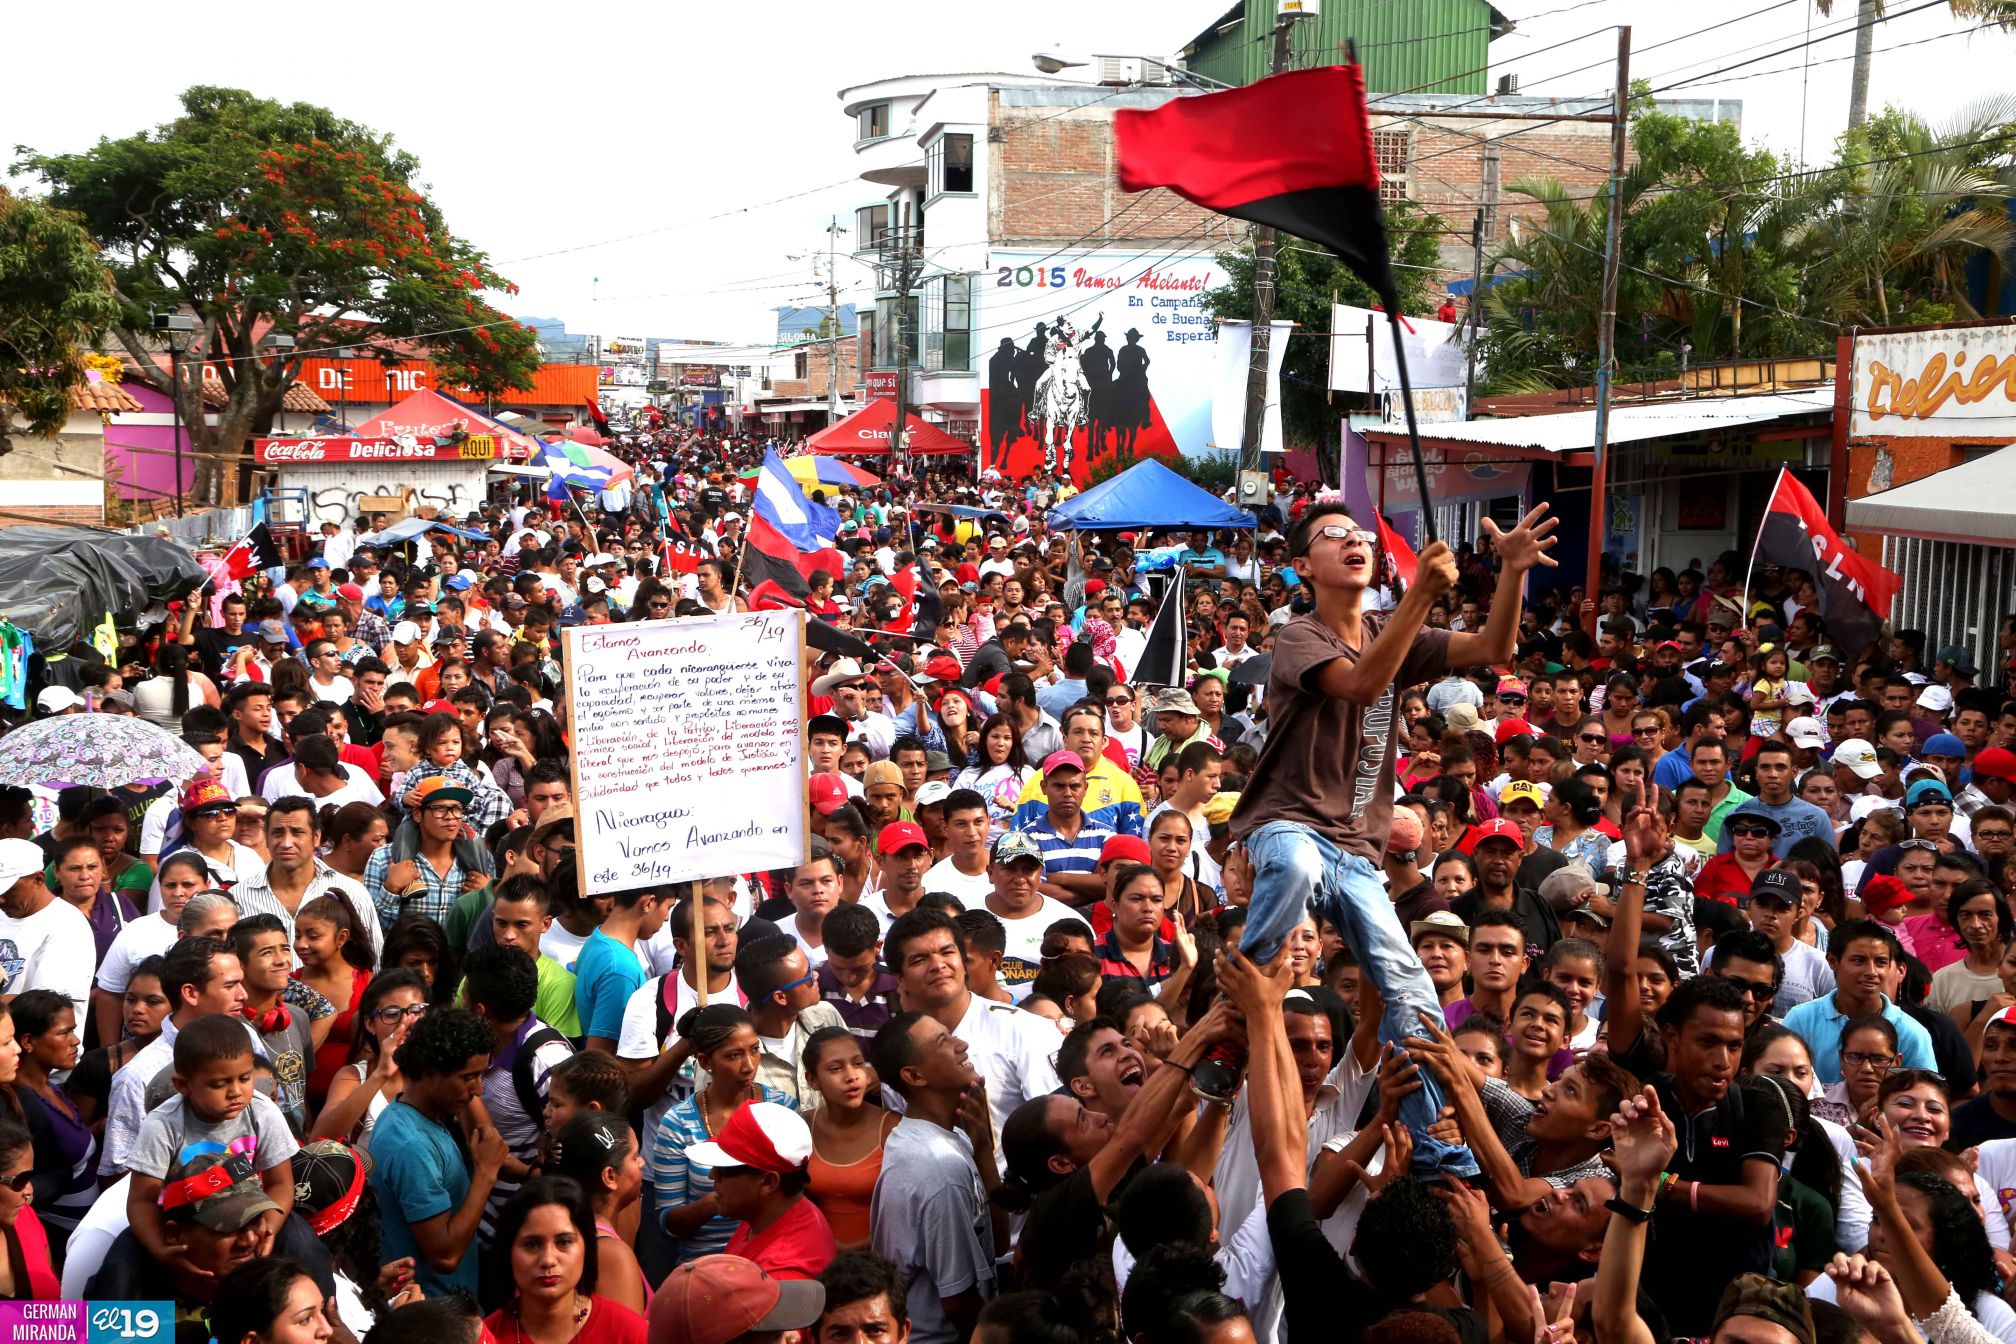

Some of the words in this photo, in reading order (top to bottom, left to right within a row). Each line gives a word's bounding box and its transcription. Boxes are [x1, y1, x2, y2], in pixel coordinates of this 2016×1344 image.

[997, 266, 1066, 288] 2015
[1073, 267, 1121, 289] Vamos
[1136, 267, 1211, 291] Adelante!
[1128, 296, 1144, 307] En
[1152, 313, 1167, 324] de
[780, 332, 816, 341] GLORIA
[319, 367, 353, 389] DE
[581, 633, 641, 653] Estamos
[578, 664, 607, 683] Para
[615, 672, 636, 686] que
[643, 663, 673, 677] cada
[766, 656, 795, 667] viva
[599, 678, 661, 697] recuperación
[668, 676, 680, 687] de
[687, 677, 699, 685] su
[705, 675, 733, 689] poder
[755, 672, 767, 681] de
[640, 691, 686, 703] recuperar
[735, 684, 762, 698] dejar
[770, 679, 797, 691] atrás
[578, 710, 586, 720] el
[668, 699, 692, 712] parte
[702, 698, 713, 707] de
[610, 720, 629, 728] con
[633, 714, 667, 725] sentido
[646, 728, 659, 739] de
[667, 726, 677, 736] la
[725, 717, 777, 731] Liberación
[664, 734, 715, 746] Liberación
[721, 732, 733, 741] del
[741, 728, 775, 739] modelo
[580, 754, 612, 769] liberal
[617, 756, 634, 768] que
[642, 753, 658, 762] nos
[708, 744, 731, 756] para
[736, 741, 775, 749] avanzar
[581, 772, 590, 782] la
[598, 764, 654, 779] construcción
[660, 762, 674, 771] del
[681, 756, 716, 768] modelo
[722, 752, 732, 762] de
[738, 748, 778, 761] Justicia
[645, 780, 661, 792] que
[664, 773, 692, 785] todas
[708, 767, 734, 777] todos
[1512, 783, 1533, 792] CAT
[616, 835, 671, 859] Vamos
[686, 819, 763, 849] Avanzando
[772, 825, 788, 836] en
[593, 867, 619, 884] este
[1000, 961, 1024, 970] CLUB
